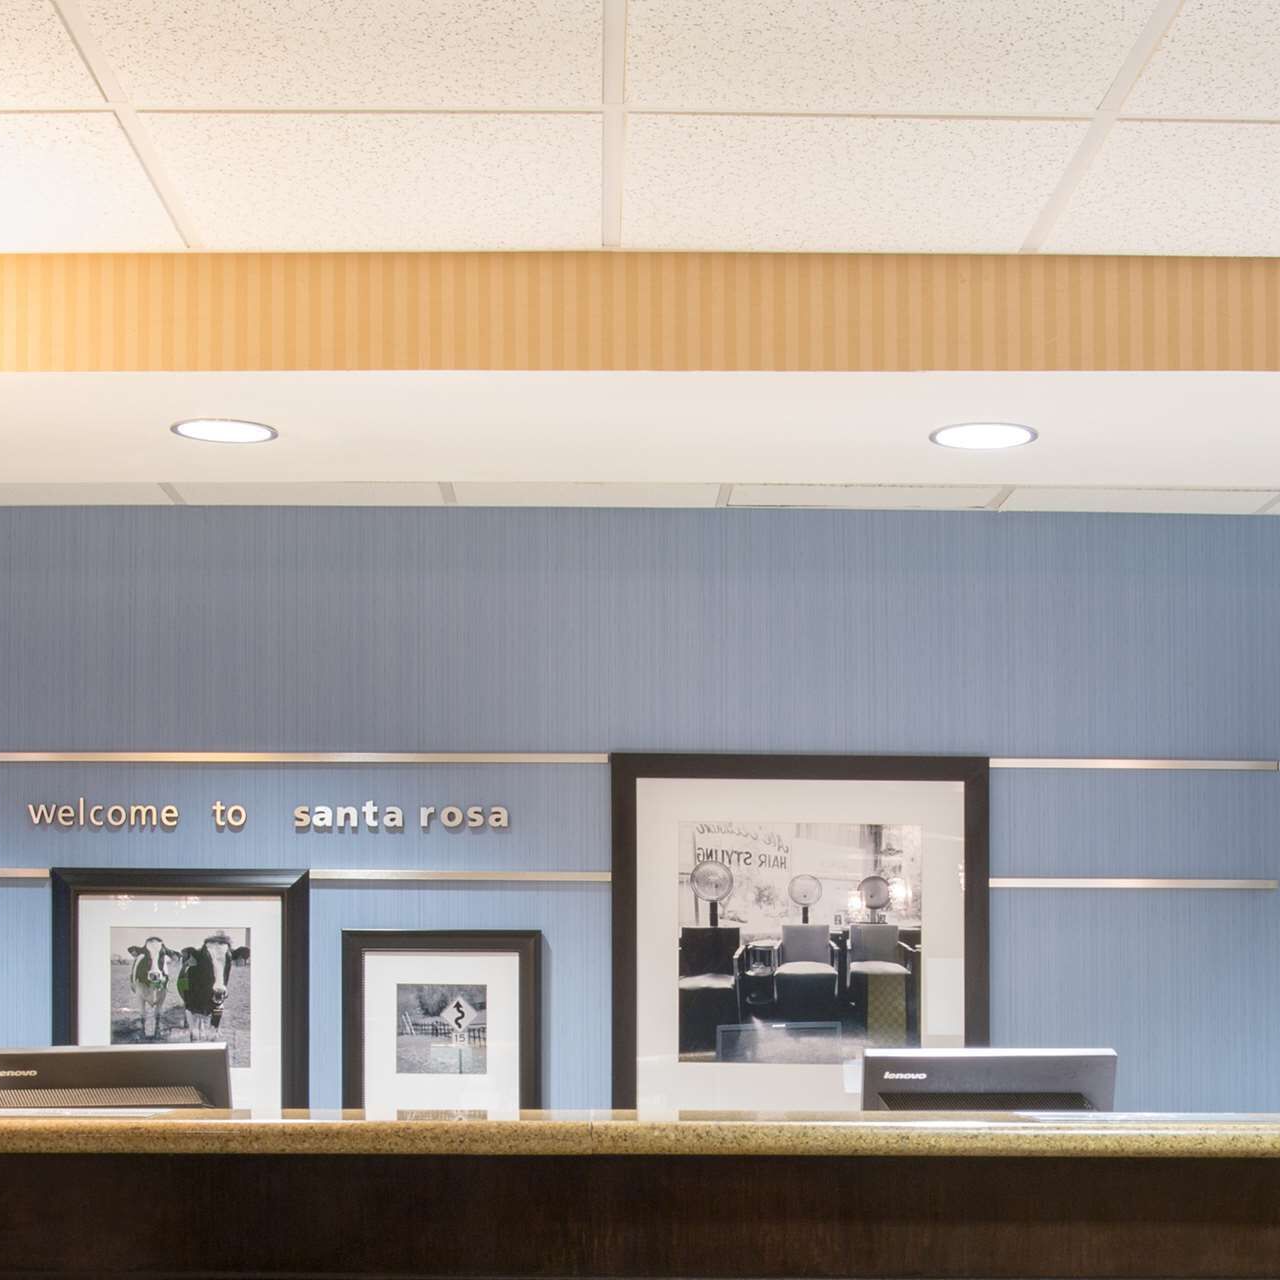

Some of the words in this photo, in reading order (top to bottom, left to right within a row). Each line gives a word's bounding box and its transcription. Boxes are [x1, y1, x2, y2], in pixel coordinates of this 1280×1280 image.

[27, 797, 179, 828] welcome
[212, 800, 248, 828] to
[293, 800, 405, 829] santa
[419, 805, 510, 829] rosa
[883, 1071, 927, 1080] lenovo
